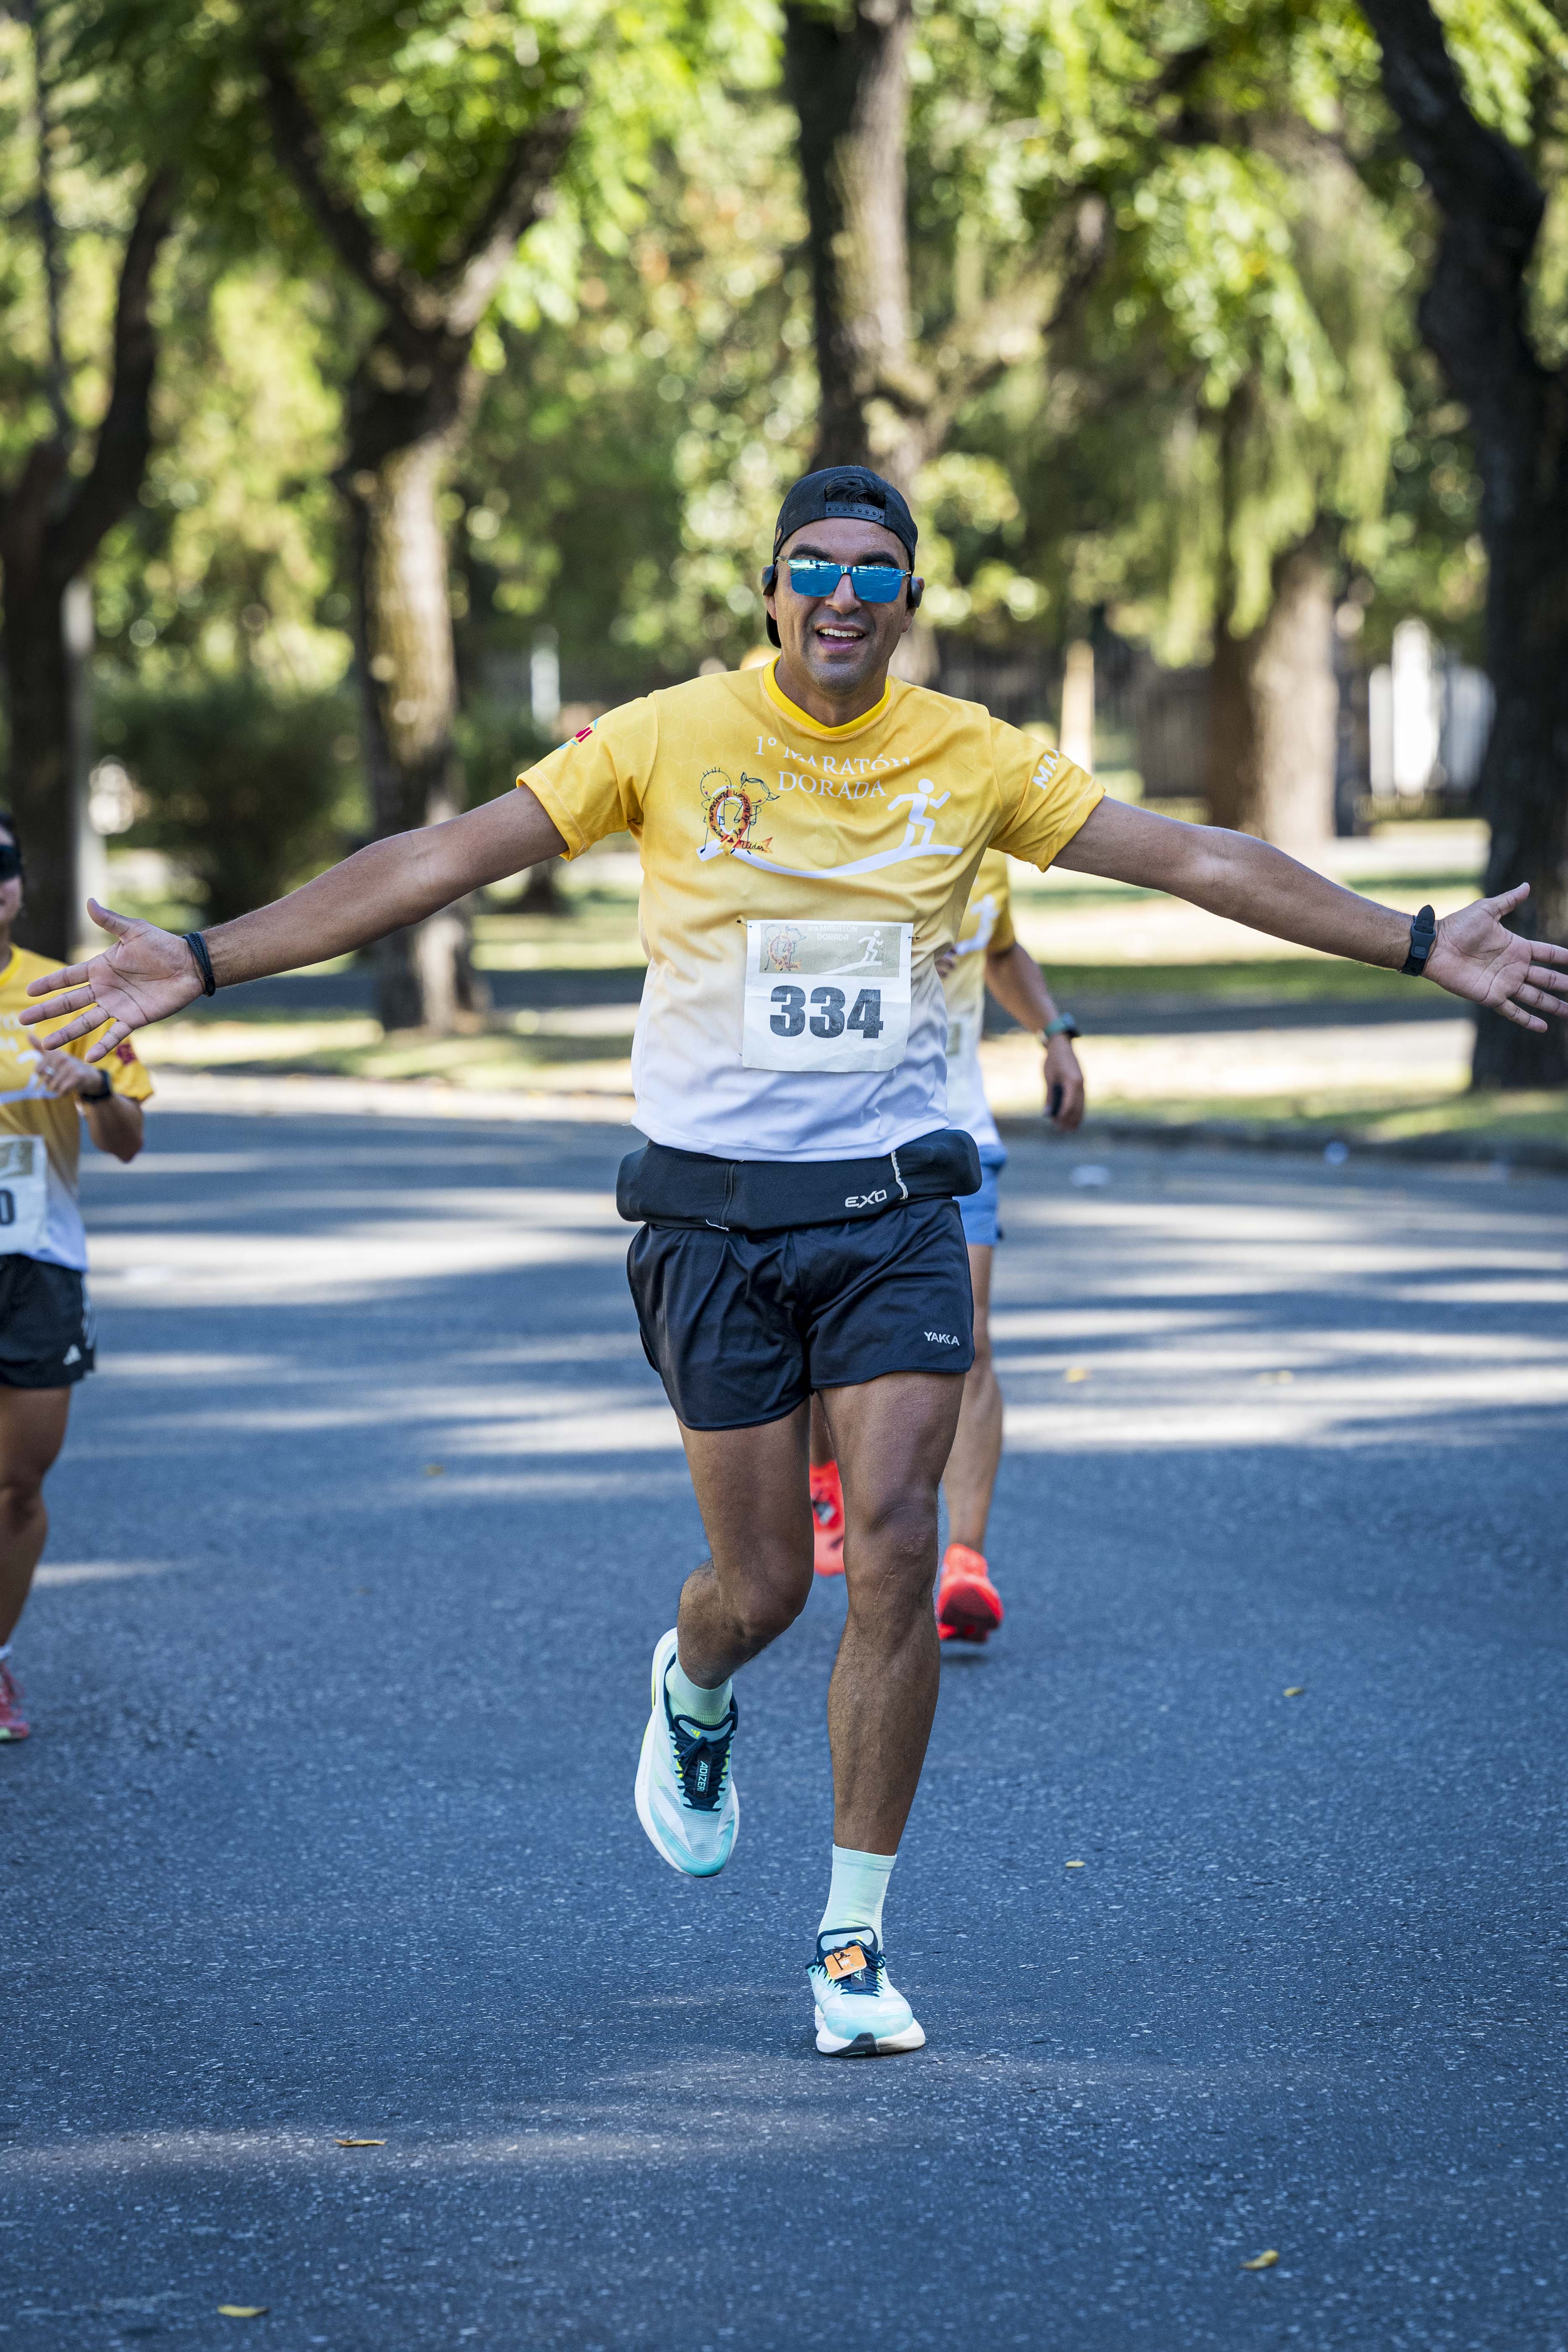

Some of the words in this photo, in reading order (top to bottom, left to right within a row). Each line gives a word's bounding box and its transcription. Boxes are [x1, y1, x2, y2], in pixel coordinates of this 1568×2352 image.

[777, 771, 887, 800] DORADA
[770, 985, 883, 1038] 334
[845, 1189, 887, 1208] EXO
